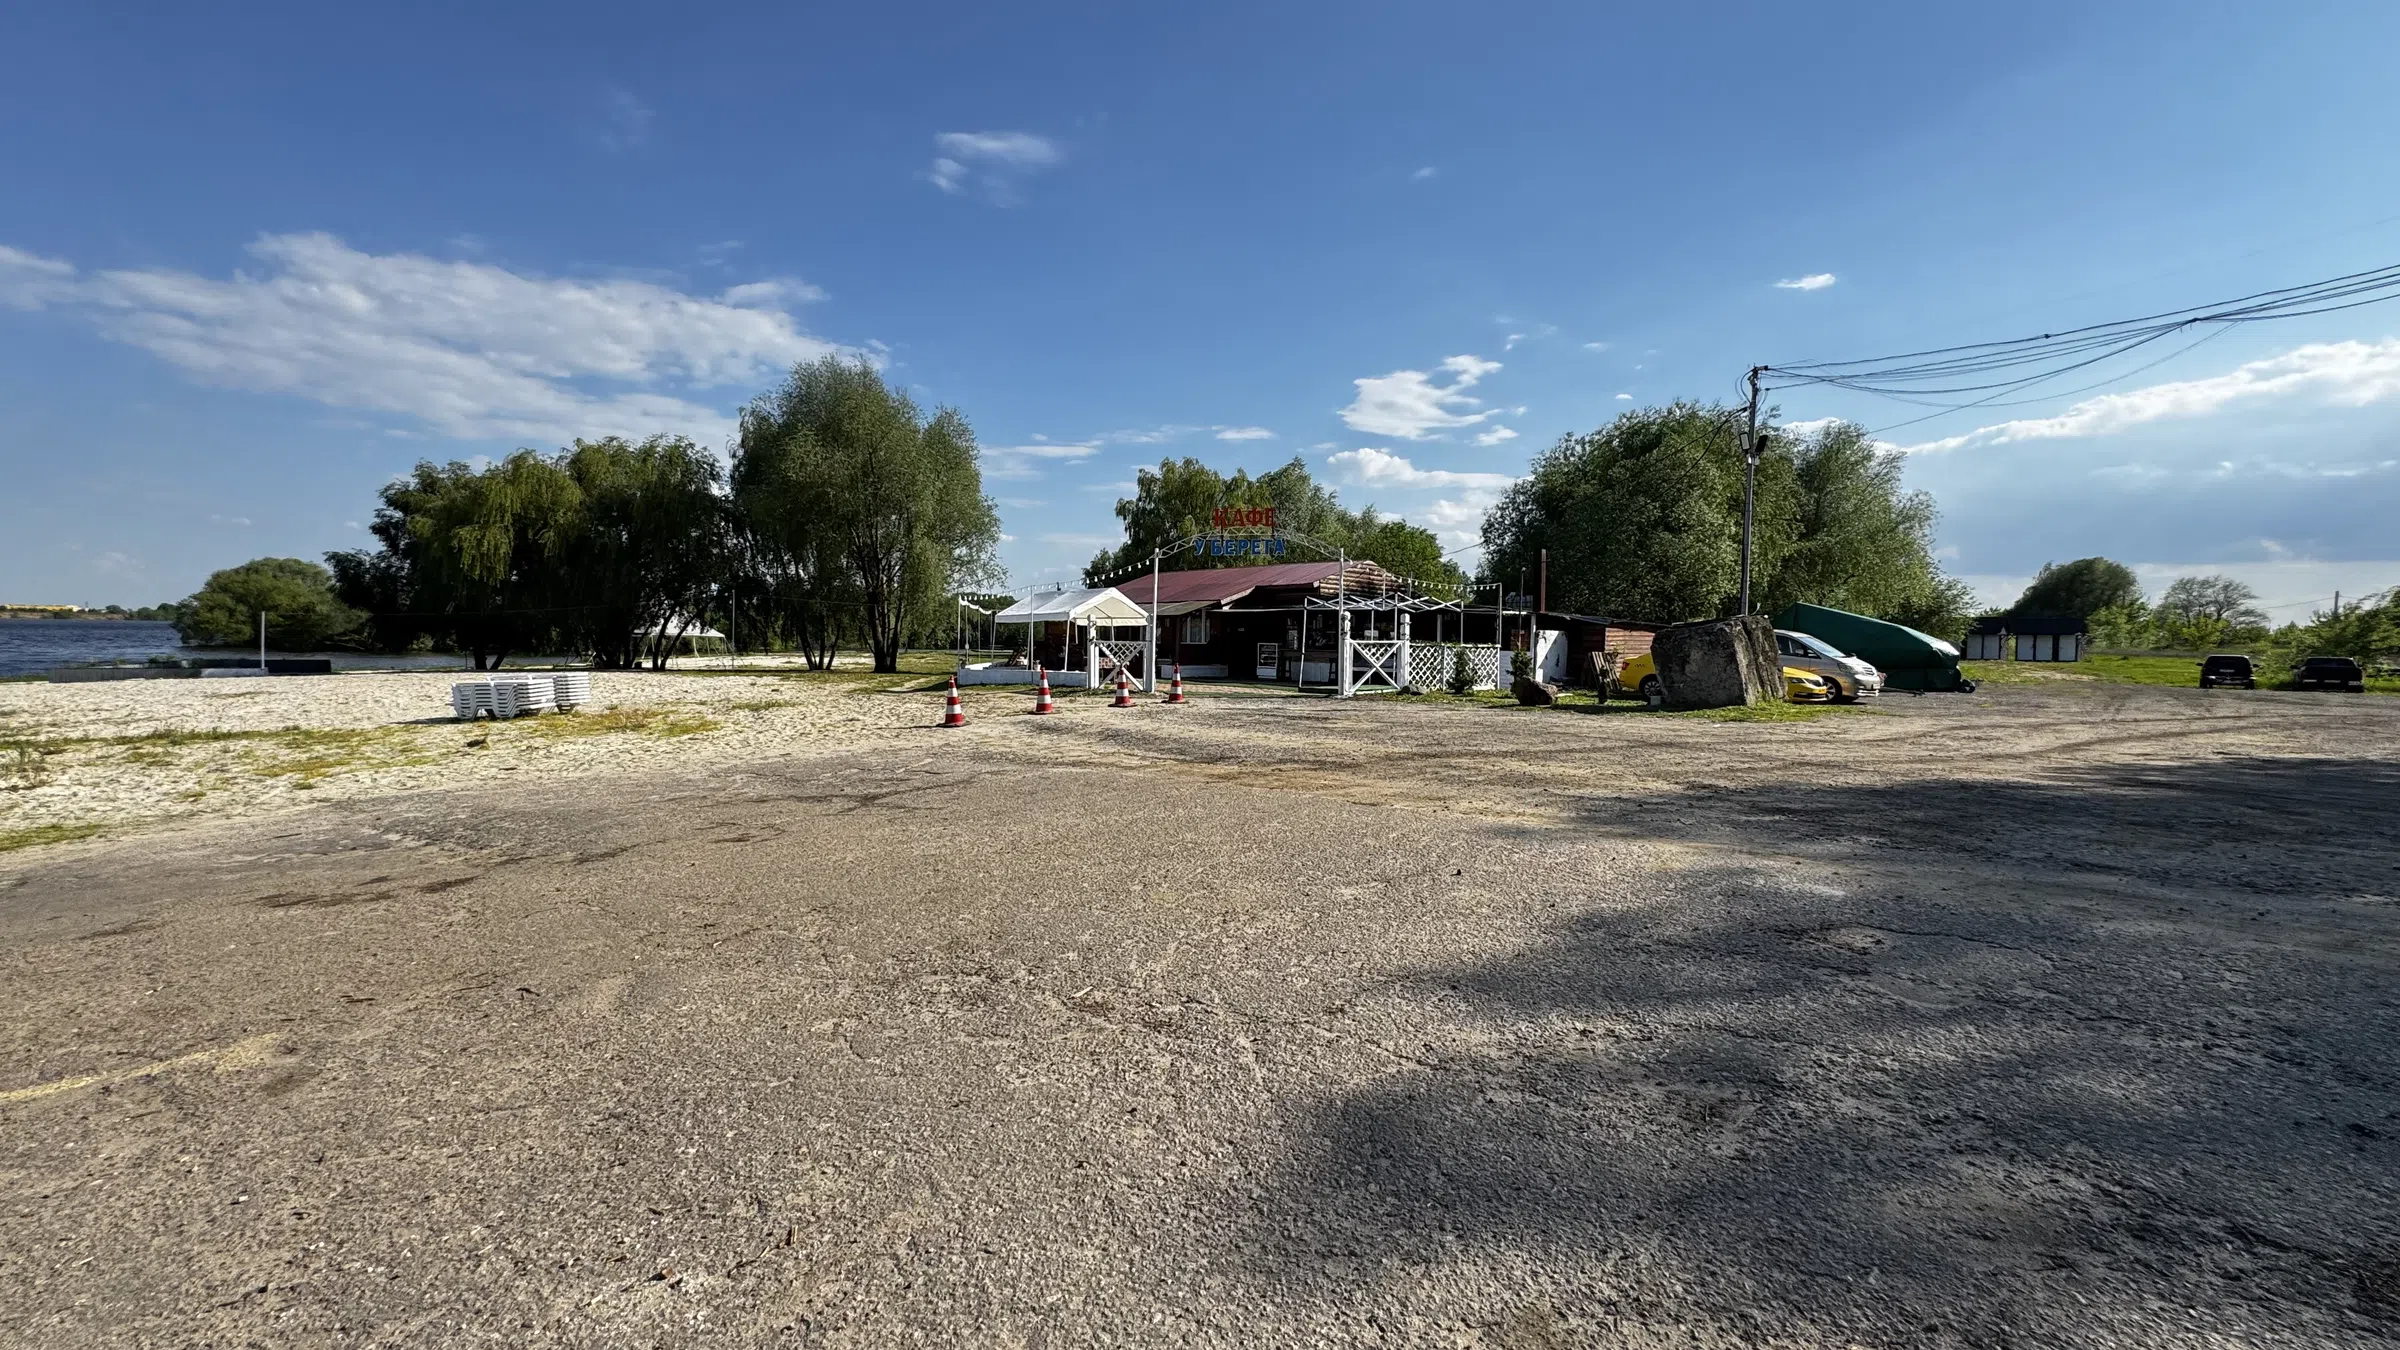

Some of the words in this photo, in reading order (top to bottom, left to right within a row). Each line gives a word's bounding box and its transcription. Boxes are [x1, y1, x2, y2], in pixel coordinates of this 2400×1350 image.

[1213, 507, 1276, 527] КАФЕ
[1194, 538, 1205, 555] У
[1211, 538, 1285, 556] БЕРЕГА
